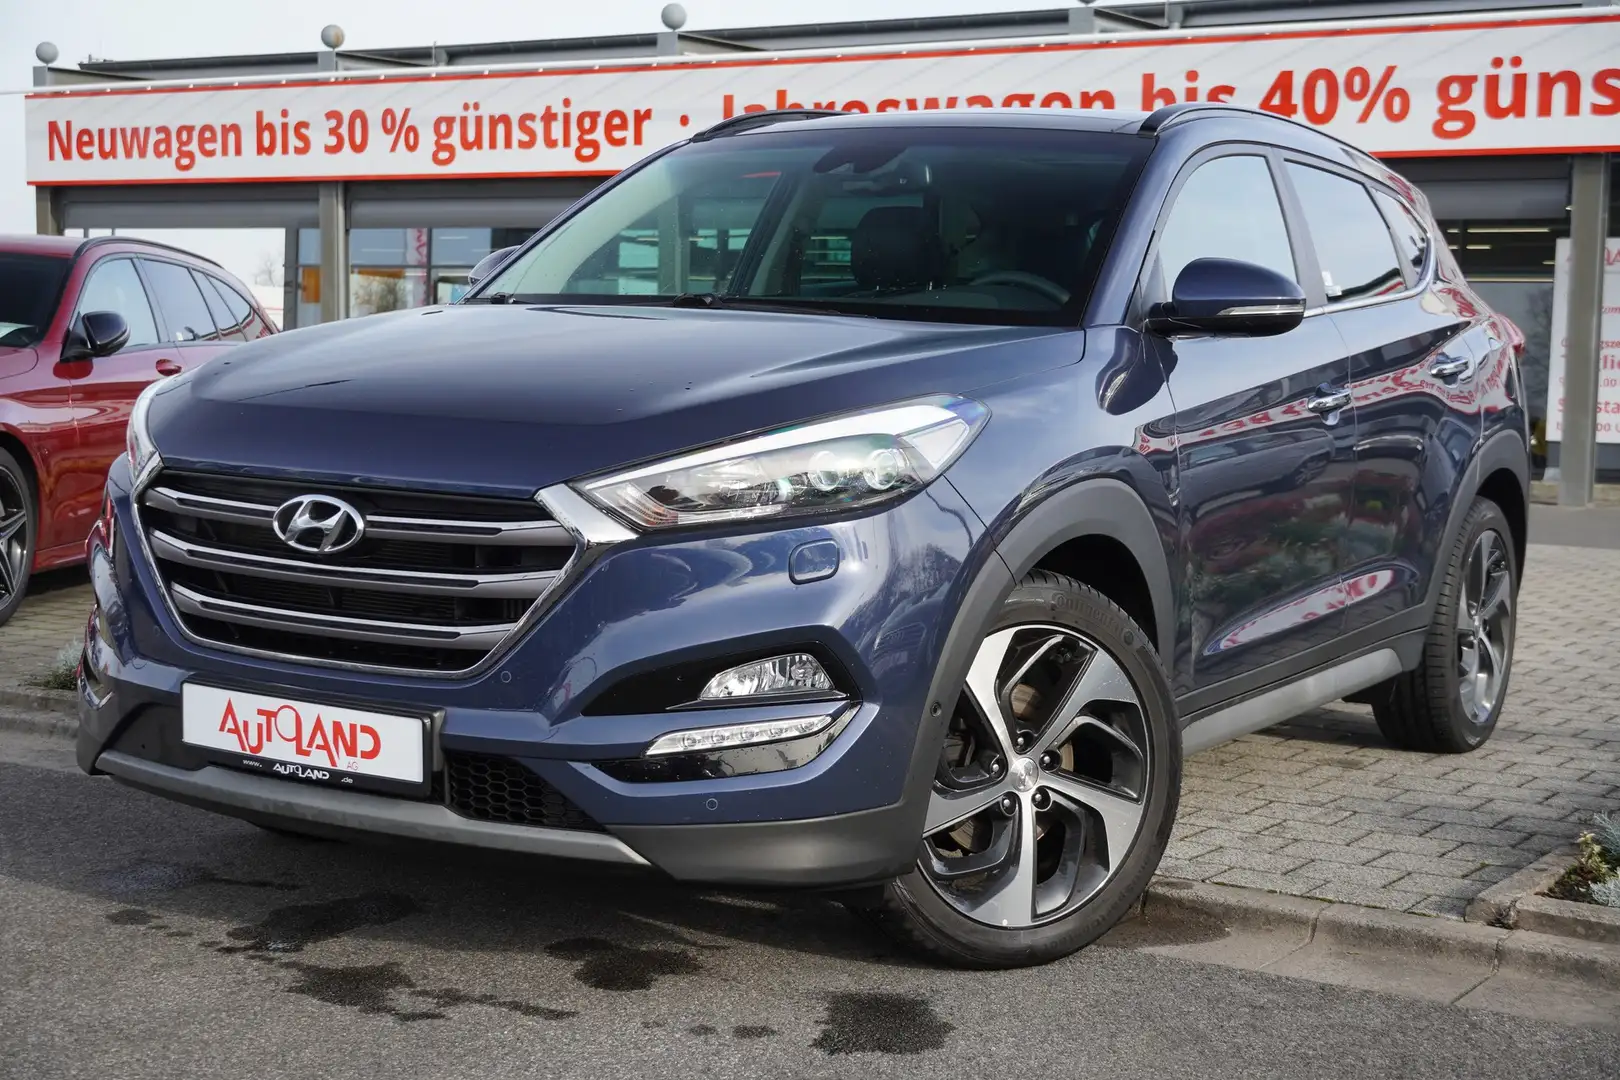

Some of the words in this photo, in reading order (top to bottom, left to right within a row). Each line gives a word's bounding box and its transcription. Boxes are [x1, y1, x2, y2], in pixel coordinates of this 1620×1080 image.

[47, 120, 243, 173] Neuwagen
[255, 108, 312, 157] bis
[323, 108, 369, 155] 30
[380, 107, 420, 153] %
[431, 97, 653, 167] günstiger
[1258, 64, 1411, 127] 40%
[346, 761, 360, 771] AG
